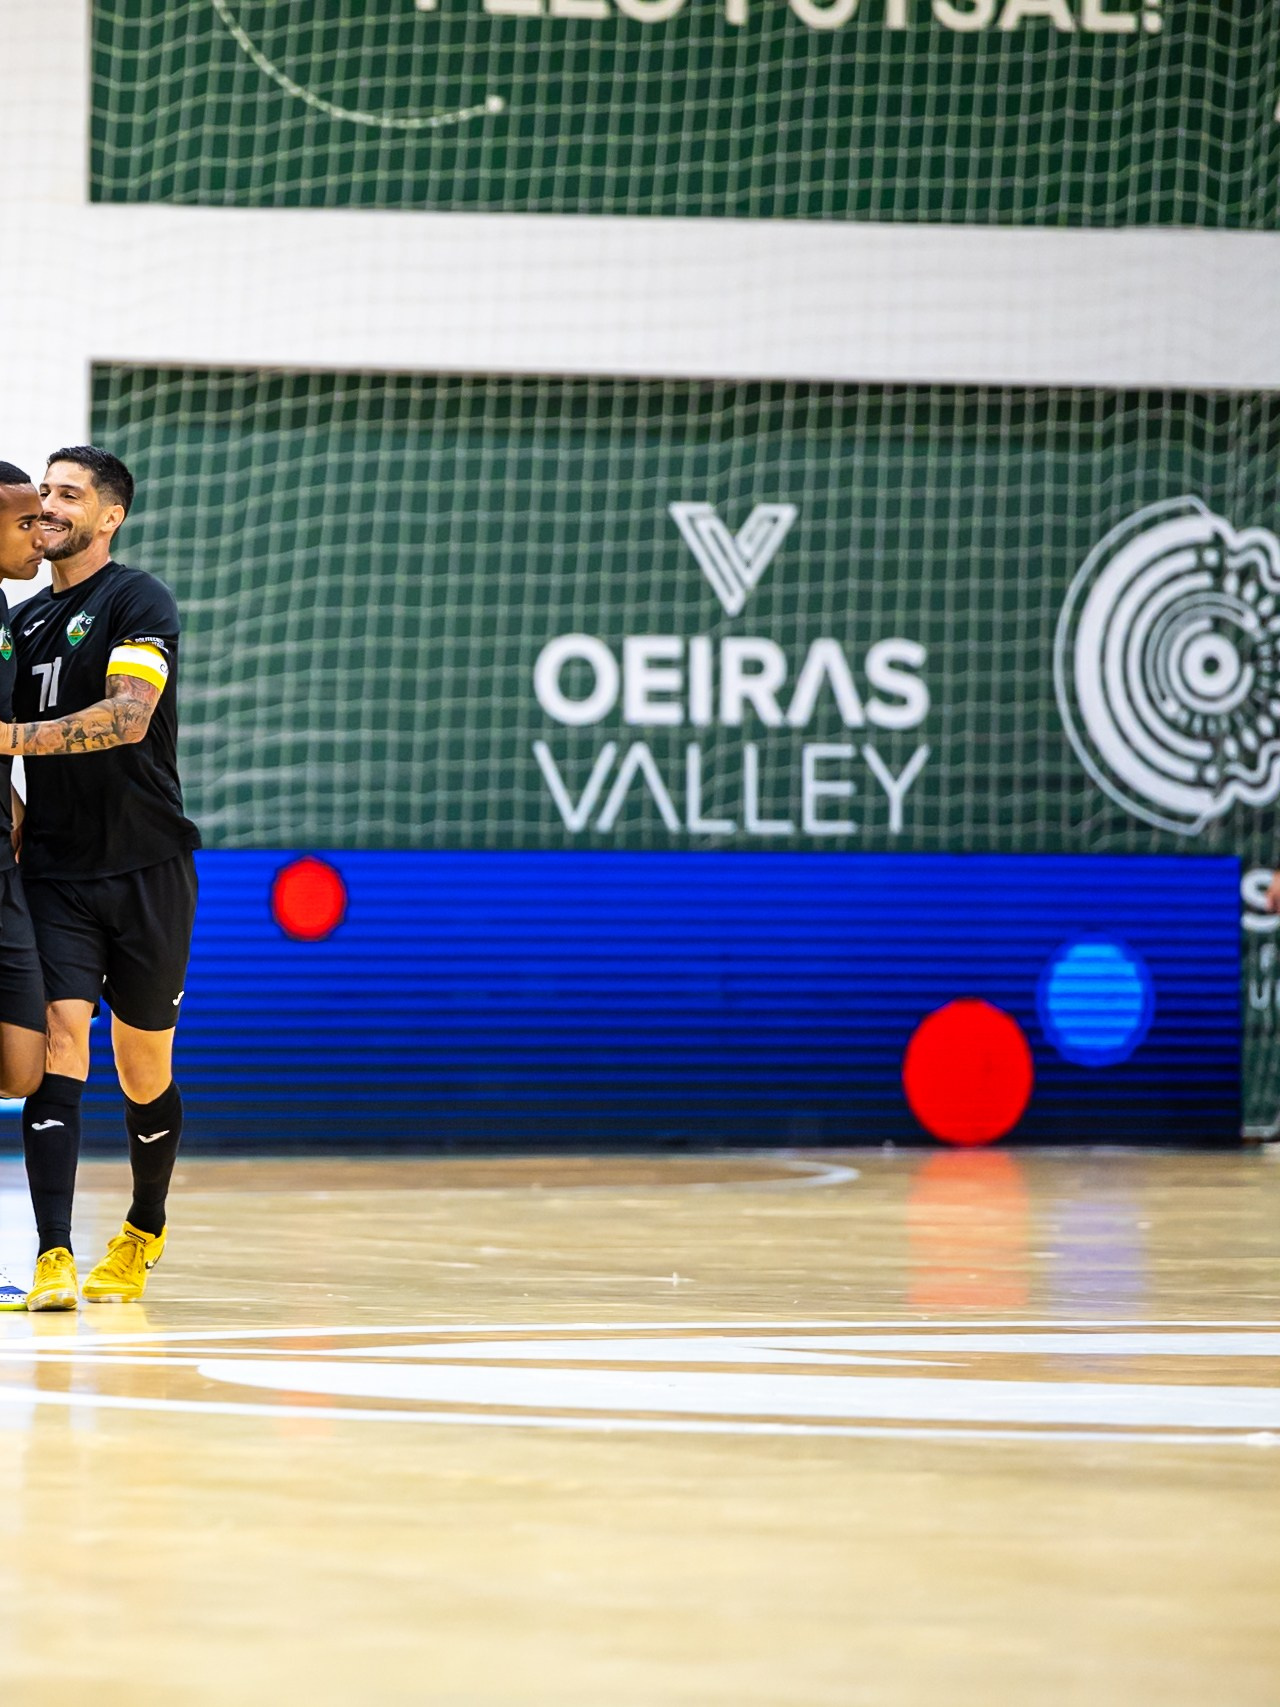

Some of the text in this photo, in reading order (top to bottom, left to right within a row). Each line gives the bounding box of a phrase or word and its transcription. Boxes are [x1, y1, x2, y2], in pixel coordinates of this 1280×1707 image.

[31, 656, 62, 712] 71
[533, 633, 929, 729] OEIRAS
[532, 741, 930, 835] VALLEY
